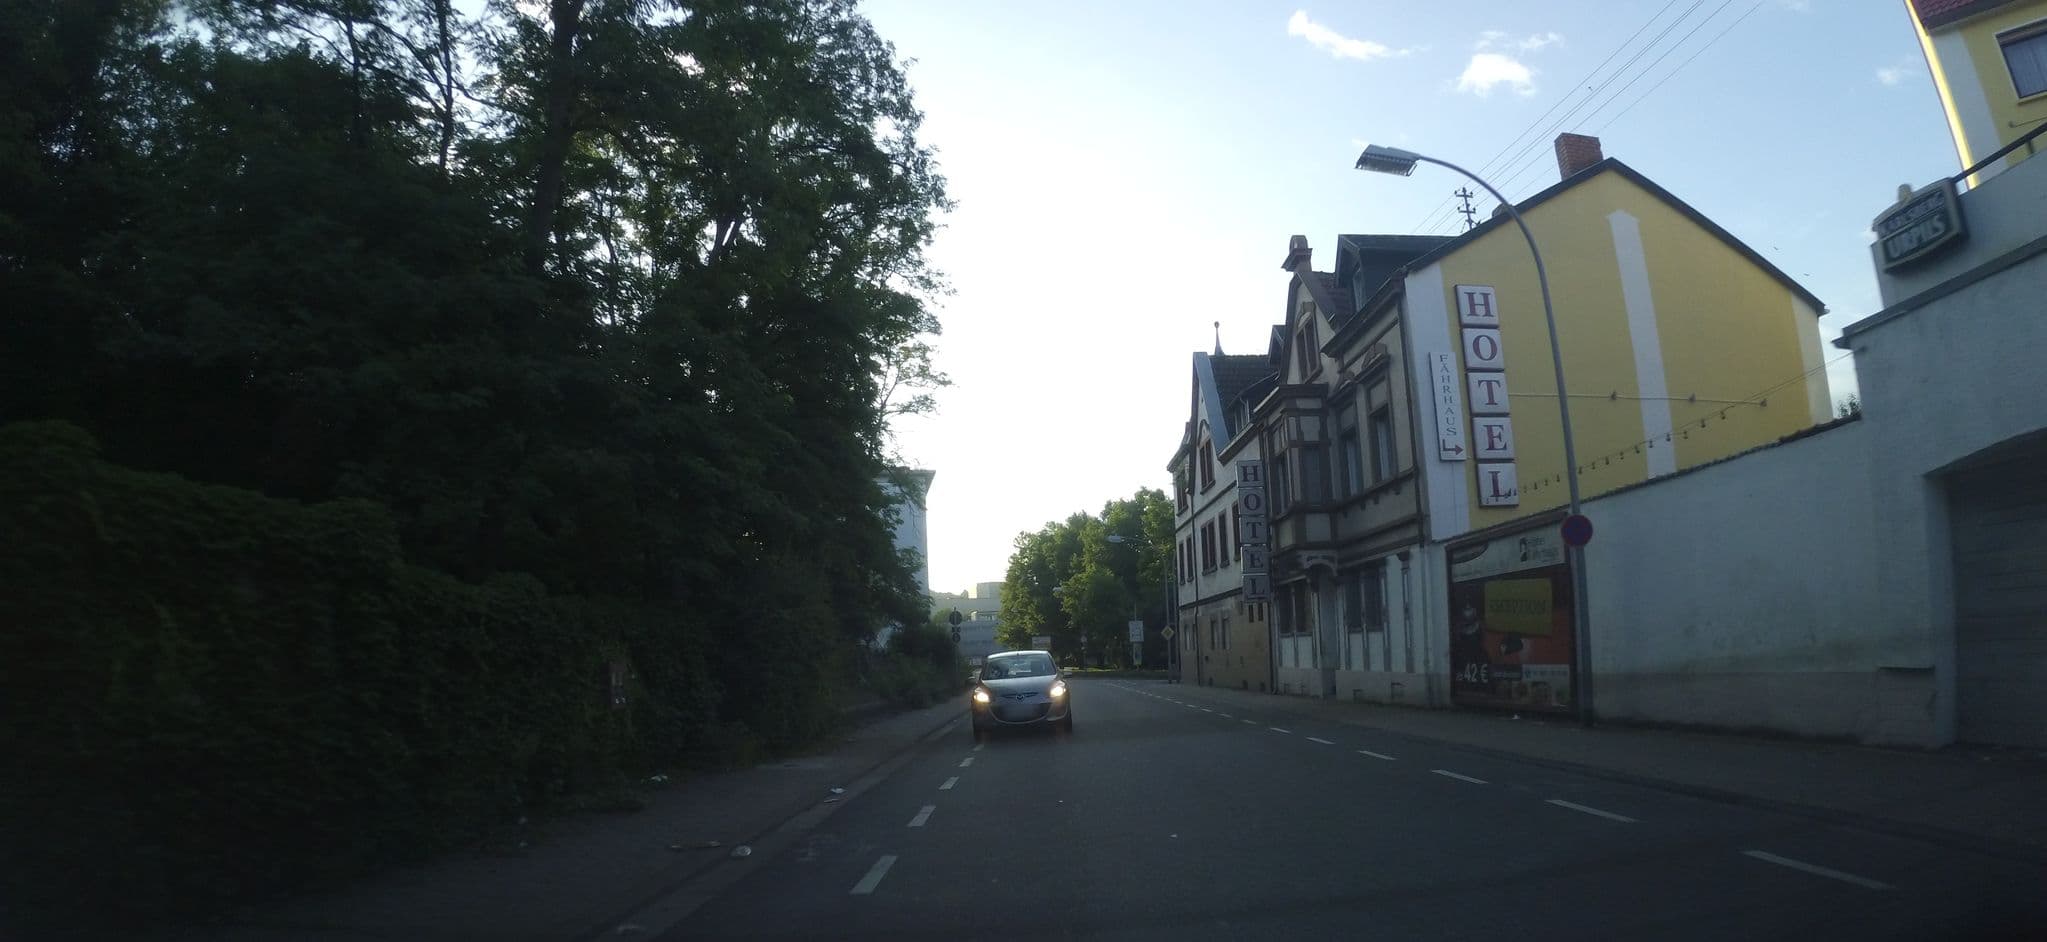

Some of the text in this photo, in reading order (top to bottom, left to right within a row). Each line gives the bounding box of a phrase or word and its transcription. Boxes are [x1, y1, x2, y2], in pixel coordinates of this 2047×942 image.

[1464, 291, 1508, 498] HOTEL
[1241, 465, 1264, 595] HOTEL
[1465, 663, 1478, 682] 42
[1480, 663, 1489, 683] €
